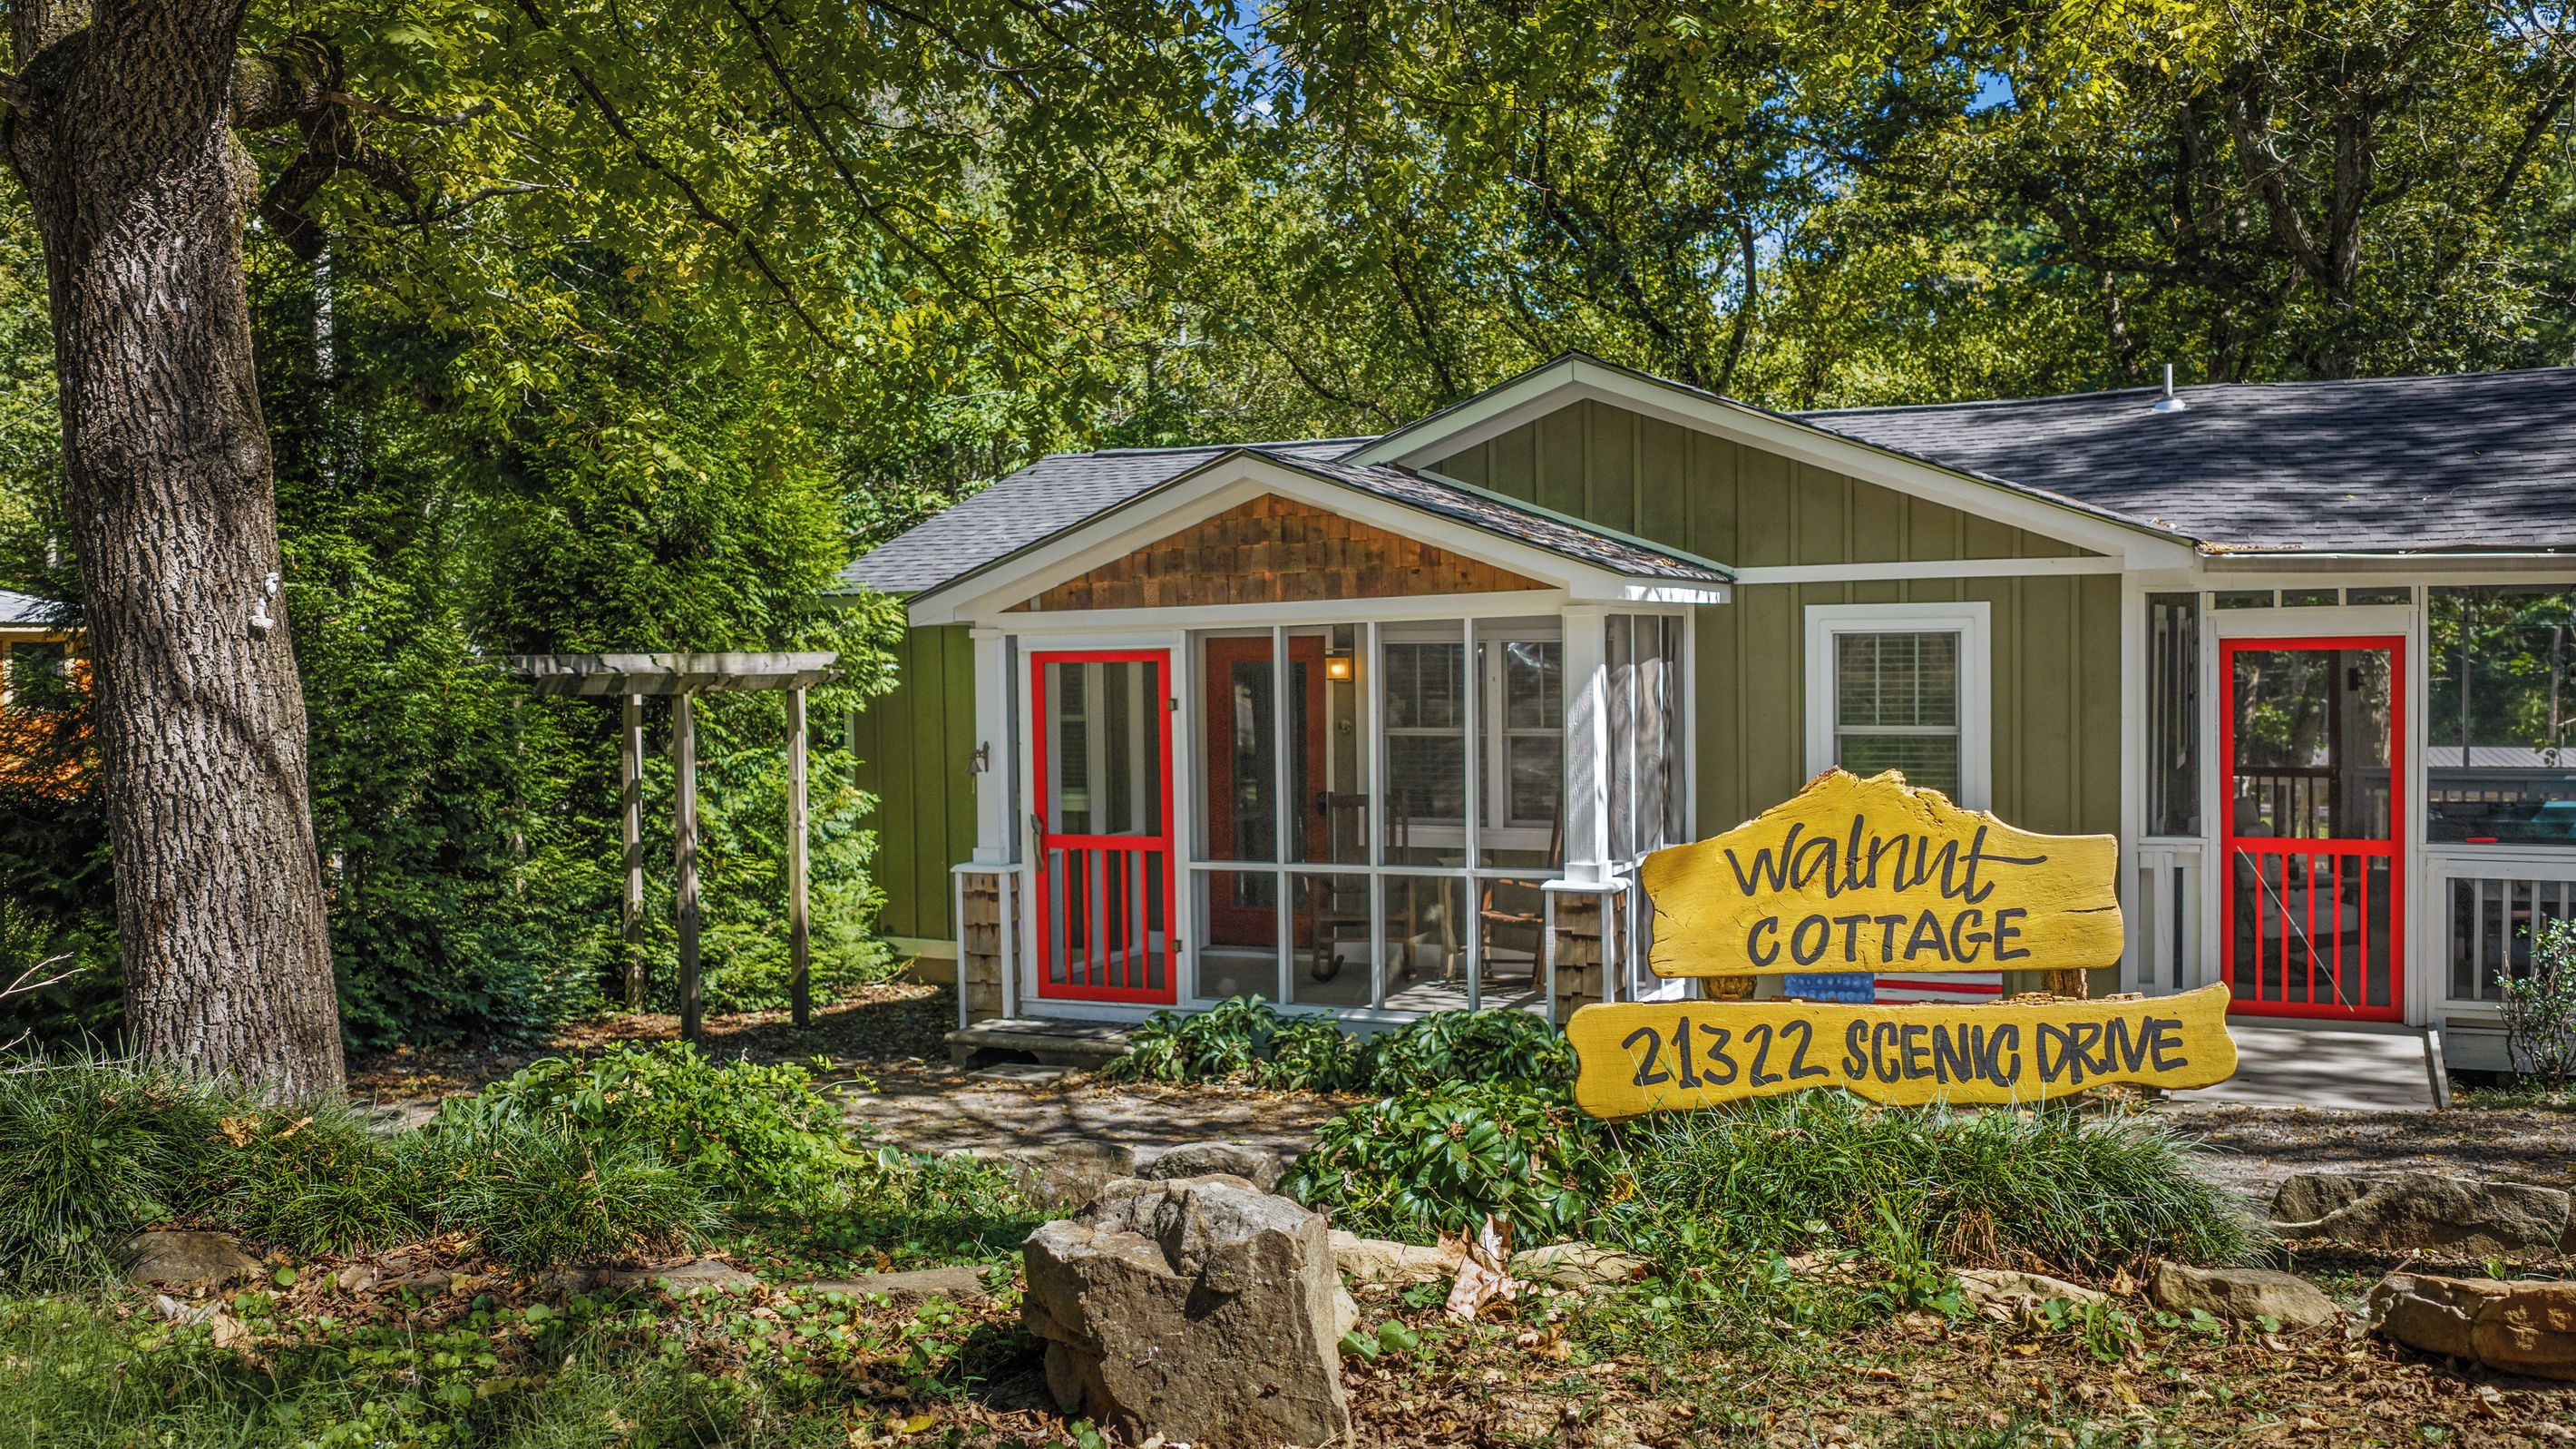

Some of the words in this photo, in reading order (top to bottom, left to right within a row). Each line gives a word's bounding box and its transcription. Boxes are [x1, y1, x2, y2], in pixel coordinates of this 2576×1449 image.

[1747, 907, 2031, 967] COTTAGE
[1622, 1015, 1830, 1089] 21322
[1841, 1019, 2021, 1087] SCENIC
[2036, 1015, 2189, 1085] DRIVE
